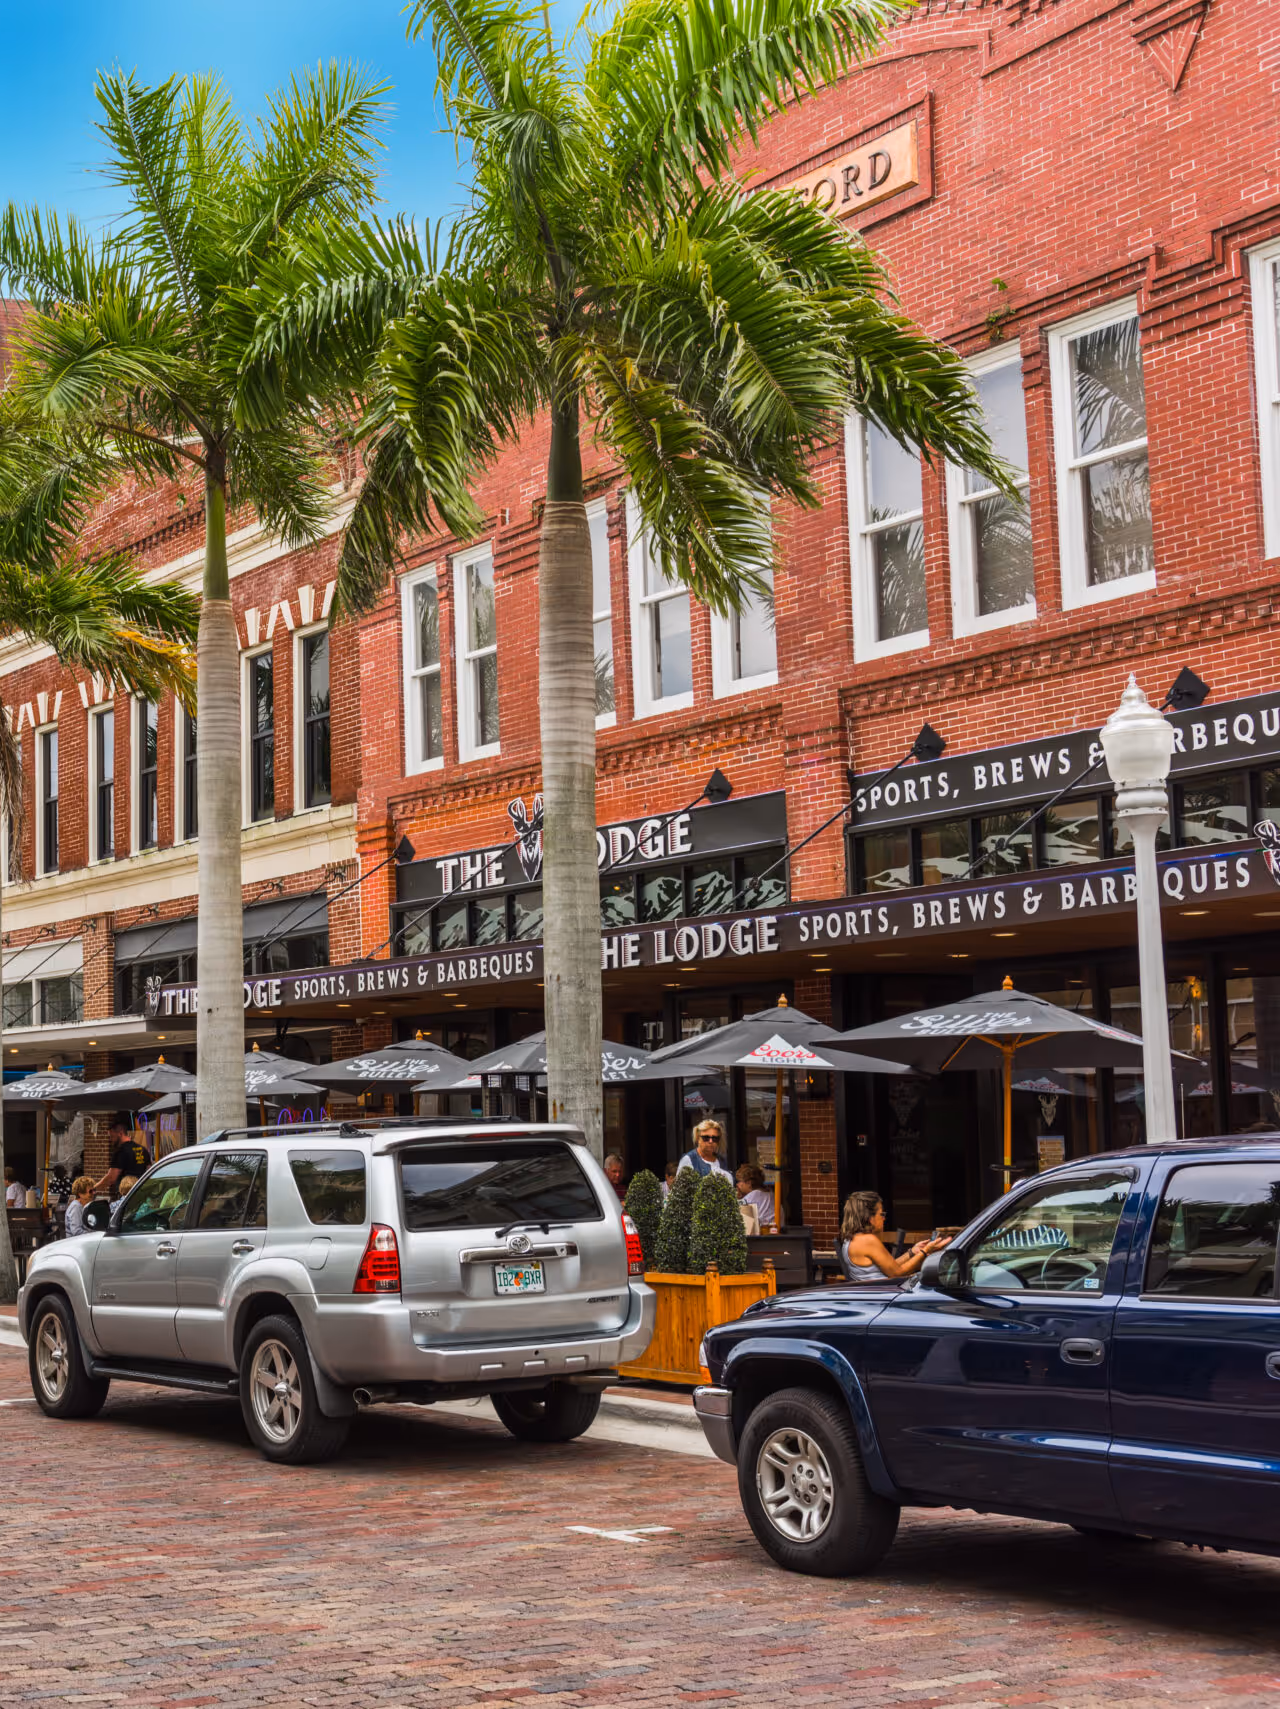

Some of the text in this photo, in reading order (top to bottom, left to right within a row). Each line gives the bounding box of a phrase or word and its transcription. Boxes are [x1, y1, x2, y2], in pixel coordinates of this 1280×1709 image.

[794, 149, 892, 212] ORD
[855, 707, 1280, 813] SPORTS, BREWS & RBEQU
[436, 813, 693, 894] THE DGE
[601, 857, 1250, 969] HE LODGE SPORTS, BREWS & BARBQUES
[244, 979, 282, 1009] DGE
[294, 974, 351, 1000] SPORTS,
[357, 967, 410, 994] BREWS
[417, 964, 429, 986] &
[437, 950, 534, 984] BARBEQUES
[900, 1014, 1033, 1030] Silver
[346, 1058, 440, 1073] Silver
[750, 1044, 817, 1059] Coors
[762, 1056, 806, 1064] LIGHT
[497, 1271, 515, 1287] IB2
